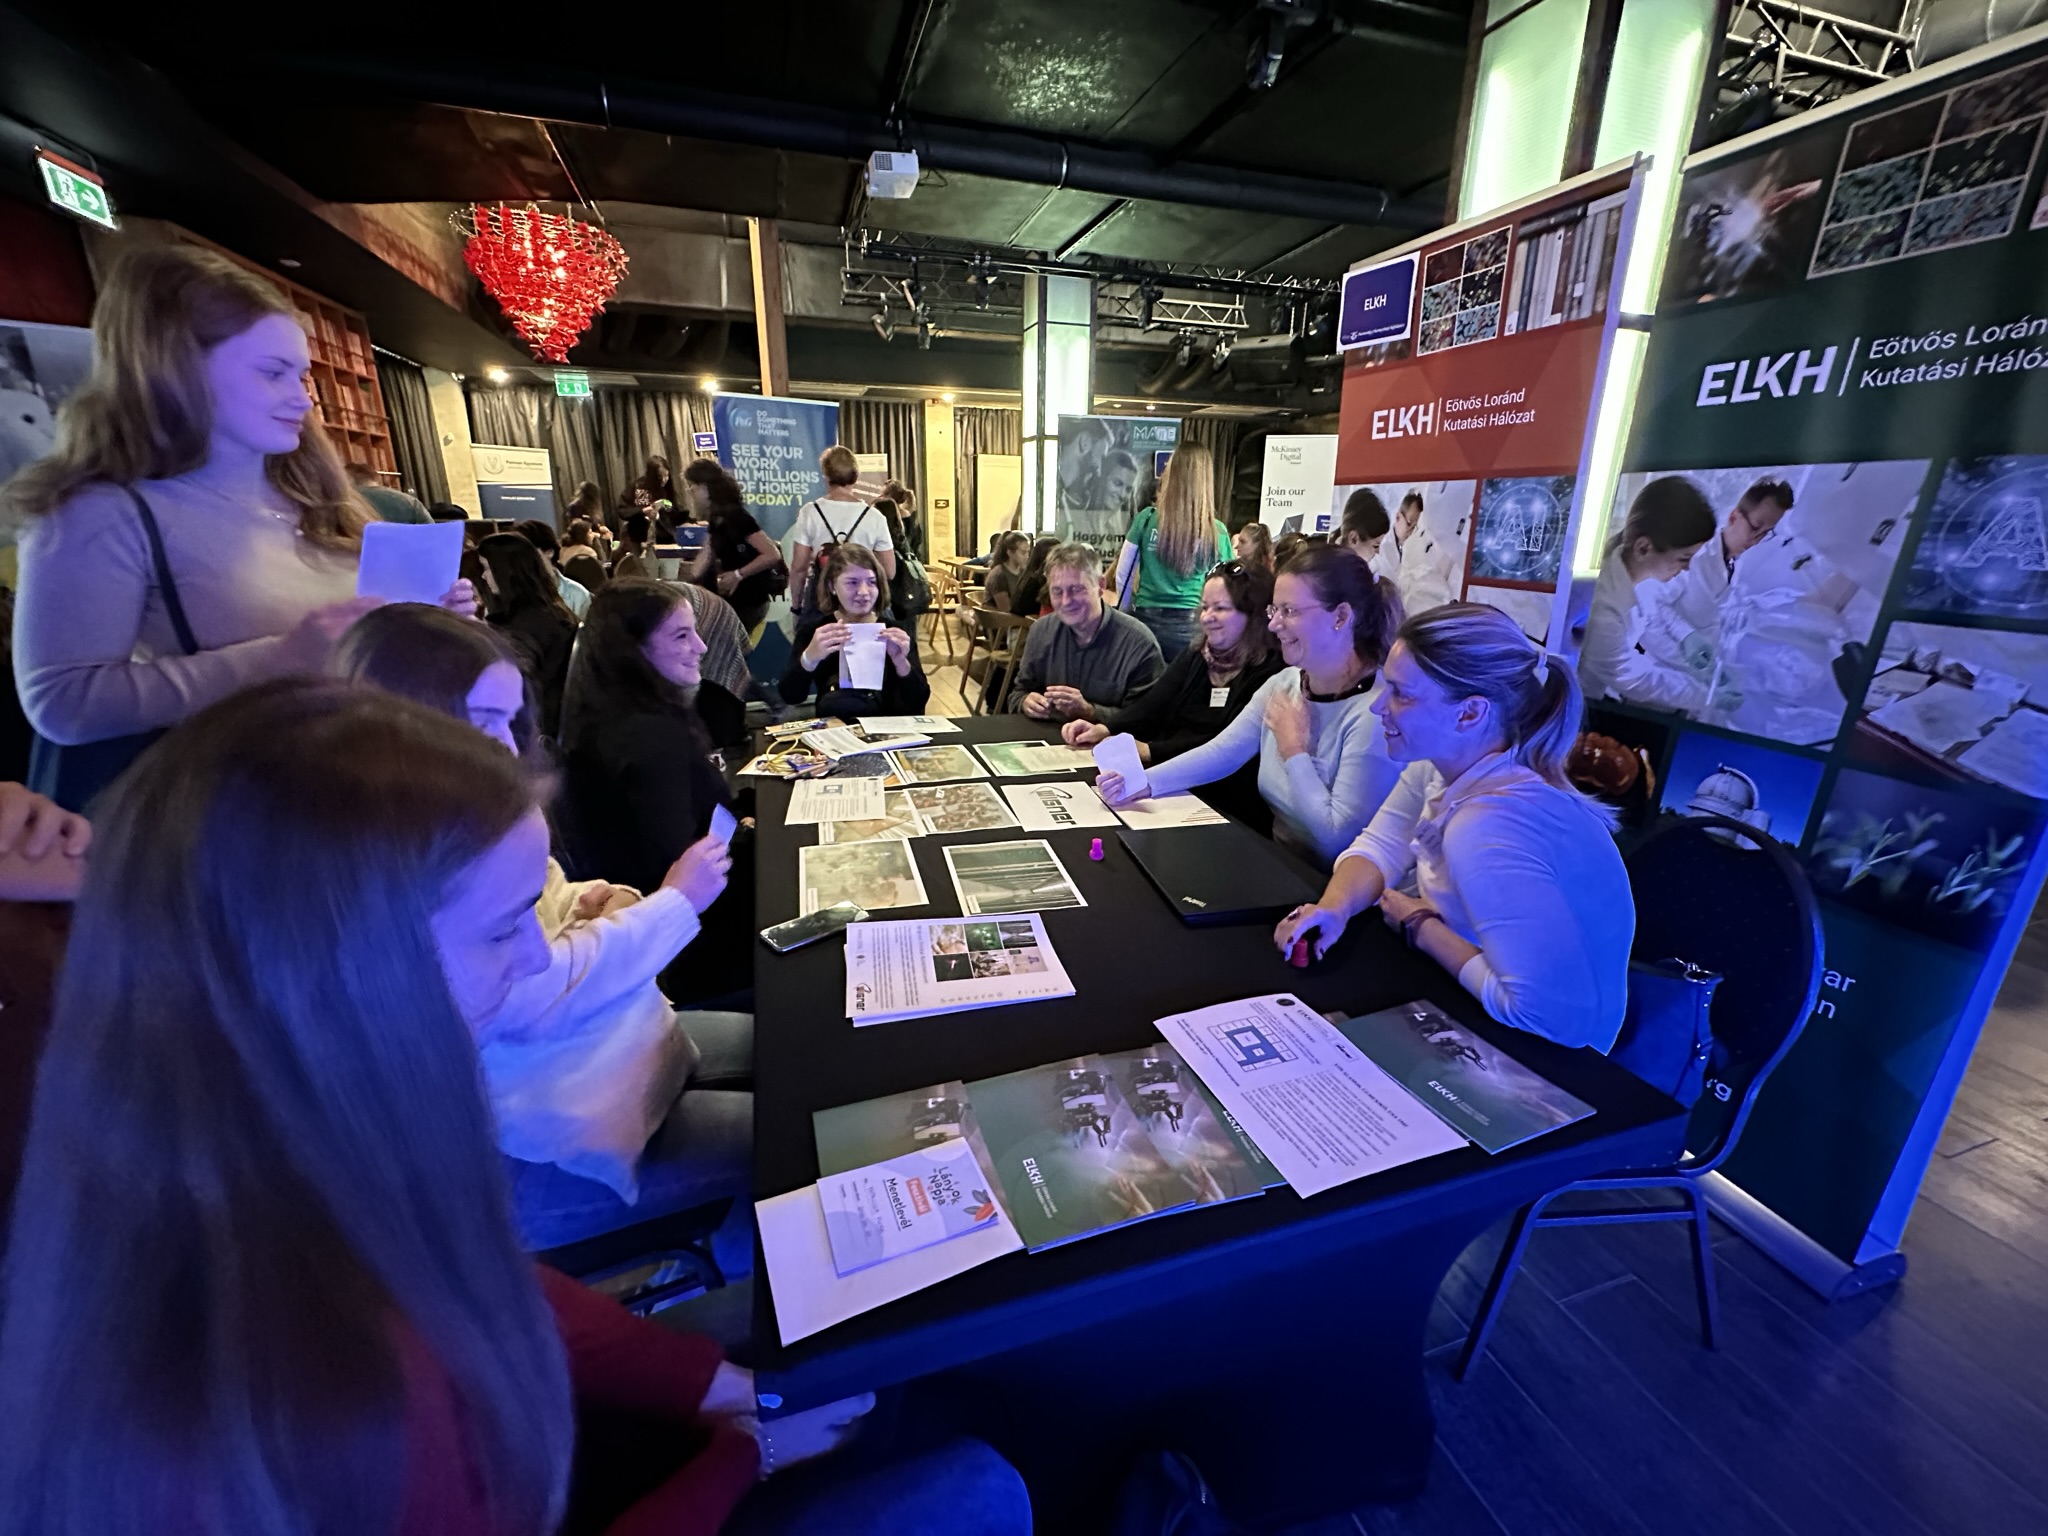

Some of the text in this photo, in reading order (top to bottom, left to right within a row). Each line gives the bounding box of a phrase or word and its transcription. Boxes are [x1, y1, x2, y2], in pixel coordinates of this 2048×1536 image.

[1363, 293, 1388, 311] ELKH
[1869, 330, 1957, 360] Eötvös
[1696, 345, 1839, 407] ELKH
[1859, 356, 1969, 389] Kutatási
[1445, 387, 1526, 412] Eötvös Loránd
[1371, 402, 1435, 440] ELKH
[1443, 408, 1536, 432] Kutatási Hálózat
[731, 443, 804, 460] SEE YOUR
[1271, 445, 1303, 453] McKinsey
[732, 456, 780, 470] WORK
[734, 468, 820, 484] IN MILLIONS
[759, 482, 810, 495] HOMES
[1266, 487, 1286, 497] Join
[796, 494, 803, 506] 1
[1266, 497, 1293, 507] Team
[1428, 1080, 1458, 1101] ELKH
[1022, 1157, 1045, 1185] ELKH
[928, 1174, 946, 1206] Napja
[938, 1166, 962, 1206] Lányok
[886, 1178, 913, 1229] Menetlevél
